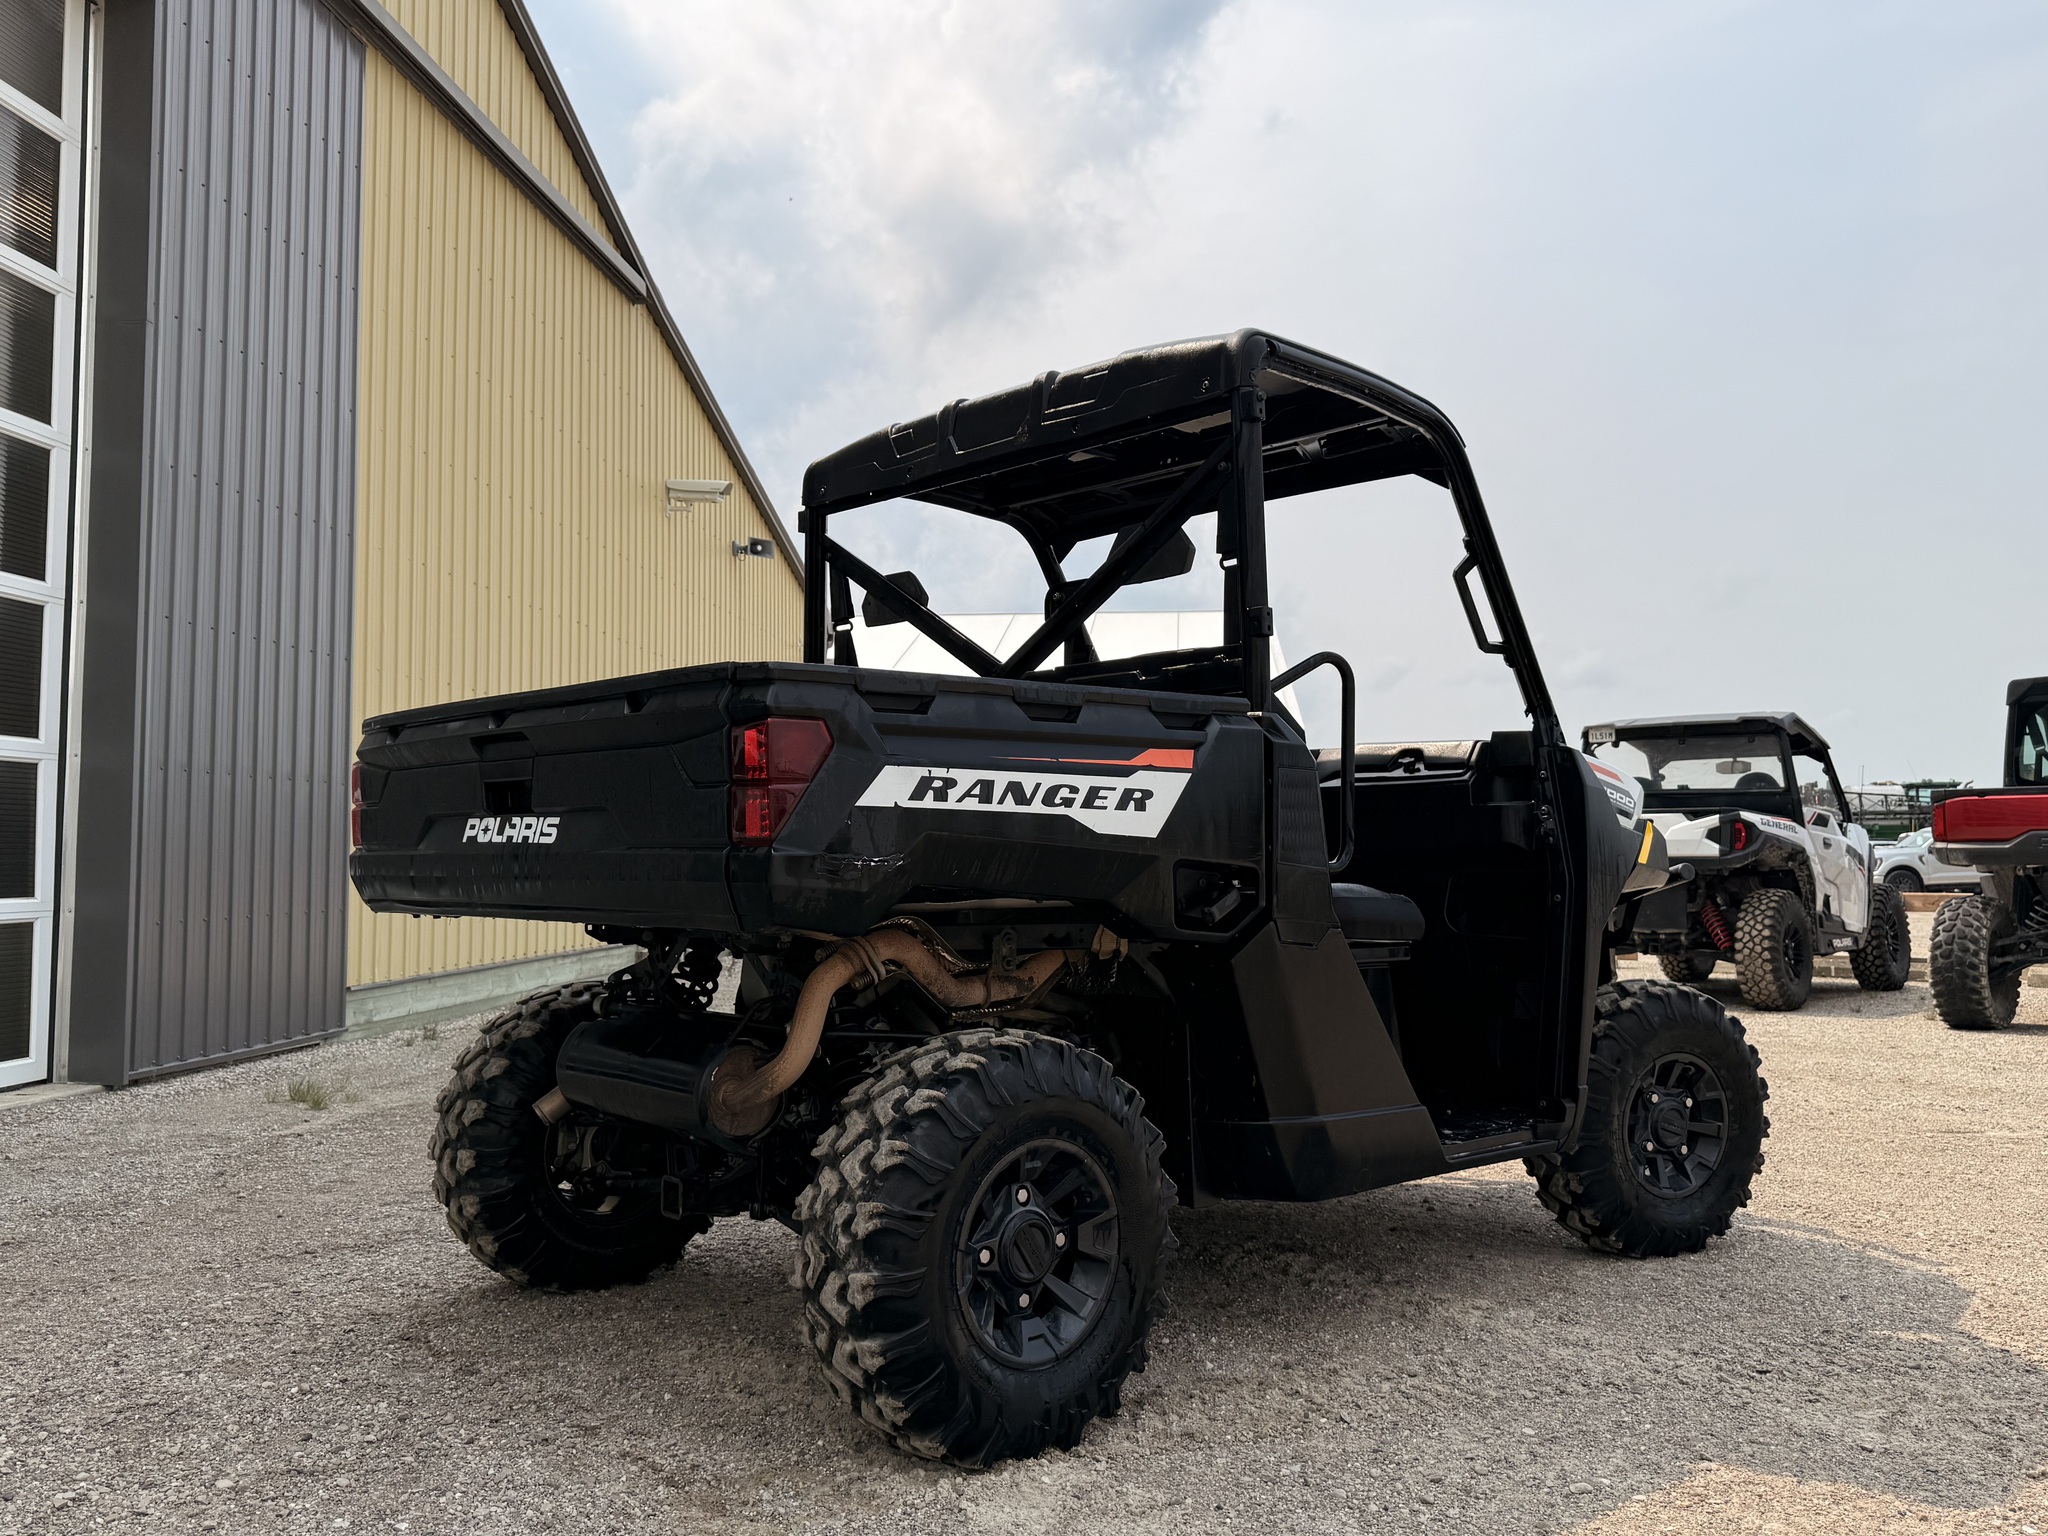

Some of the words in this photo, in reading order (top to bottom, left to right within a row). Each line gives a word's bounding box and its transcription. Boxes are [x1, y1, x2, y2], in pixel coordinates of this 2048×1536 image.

[908, 775, 1154, 812] RANGER
[1603, 786, 1634, 808] 000
[462, 817, 560, 844] POLARIS
[1760, 818, 1798, 834] GENERAL
